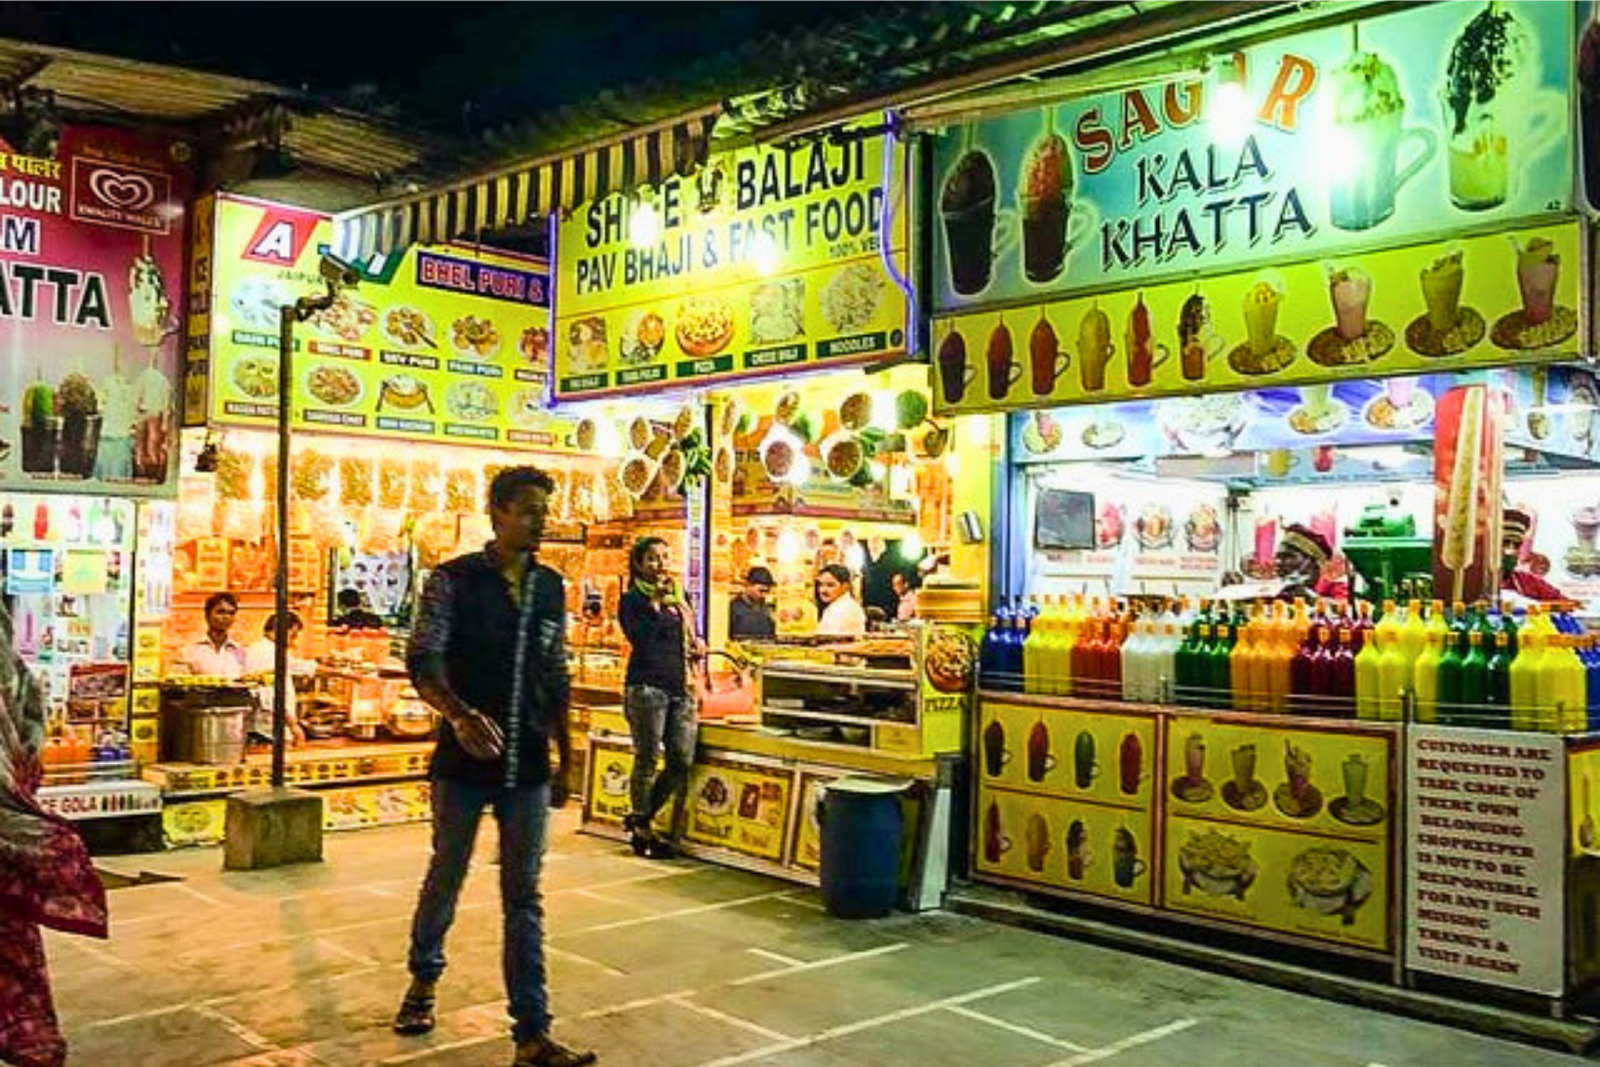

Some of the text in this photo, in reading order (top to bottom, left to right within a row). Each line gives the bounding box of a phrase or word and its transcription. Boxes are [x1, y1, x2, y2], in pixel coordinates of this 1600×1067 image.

[1075, 52, 1318, 173] SAGR
[1136, 134, 1274, 206] KALA
[586, 139, 864, 248] SHE BALAJI
[577, 253, 616, 295] PAV
[625, 234, 691, 285] BHAJI
[702, 229, 718, 268] &
[807, 187, 884, 247] FOOD
[1101, 187, 1317, 271] KHATTA
[421, 256, 475, 290] BHEL
[925, 697, 962, 712] PIZZA
[1515, 747, 1552, 760] ARE
[1417, 758, 1546, 780] REQUESTED TO
[1515, 786, 1540, 800] OF
[1477, 802, 1519, 817] OWN
[1436, 854, 1470, 869] NOT
[1475, 860, 1498, 872] TO
